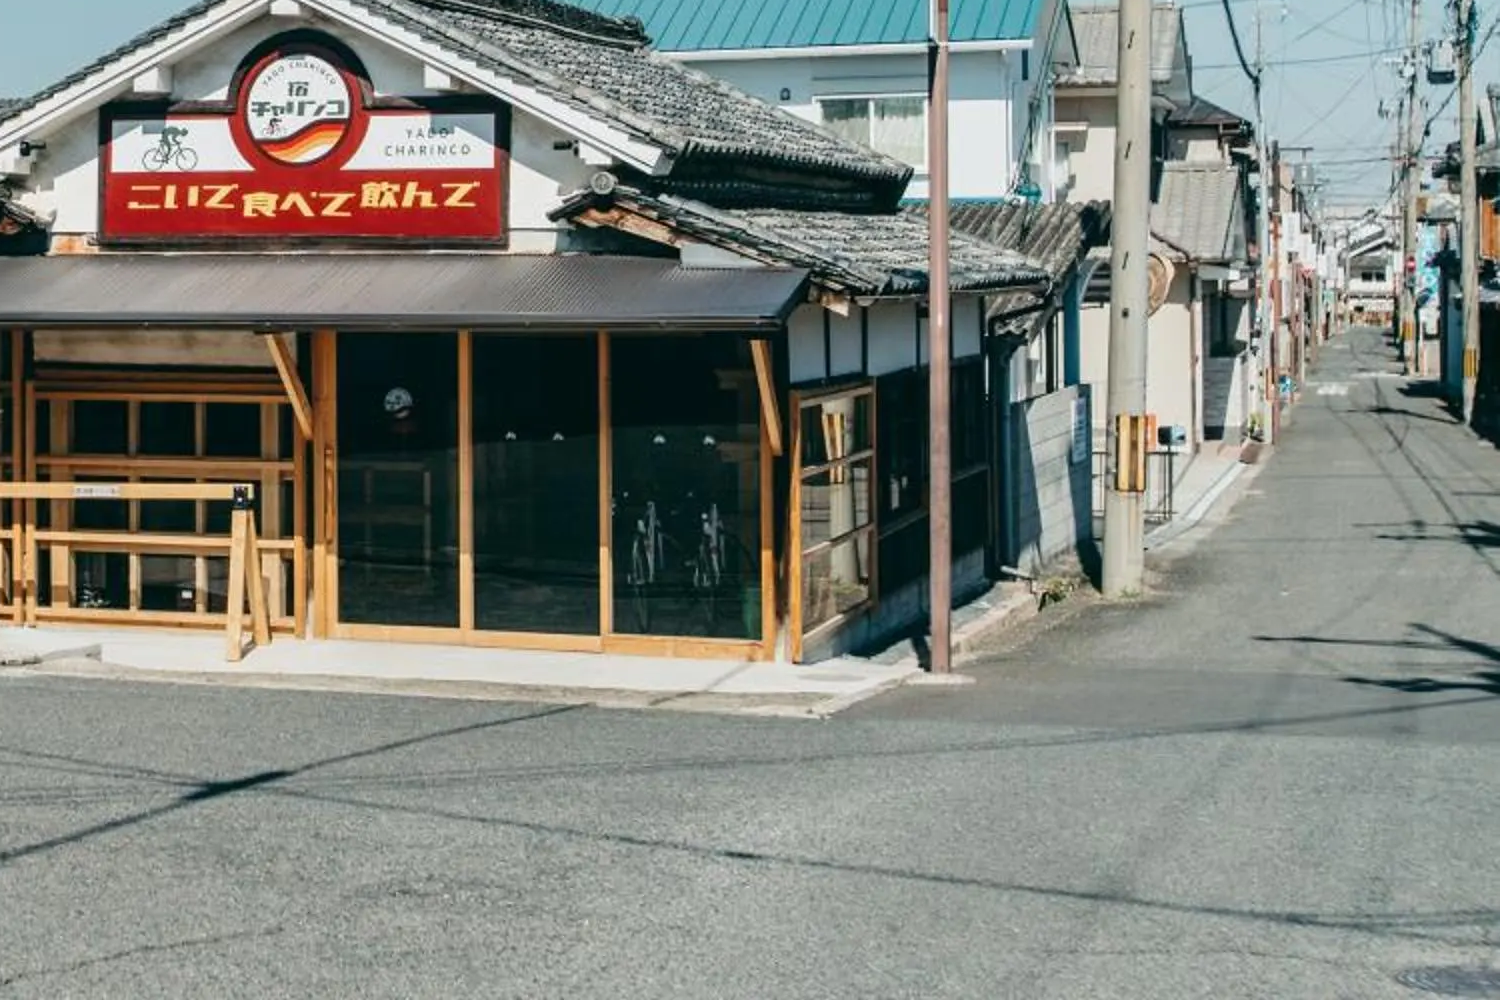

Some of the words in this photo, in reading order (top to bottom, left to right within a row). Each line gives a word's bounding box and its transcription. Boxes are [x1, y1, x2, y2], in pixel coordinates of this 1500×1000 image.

[251, 100, 345, 117] チャリンコ
[404, 127, 450, 139] YADO
[384, 143, 471, 157] CHARINCO
